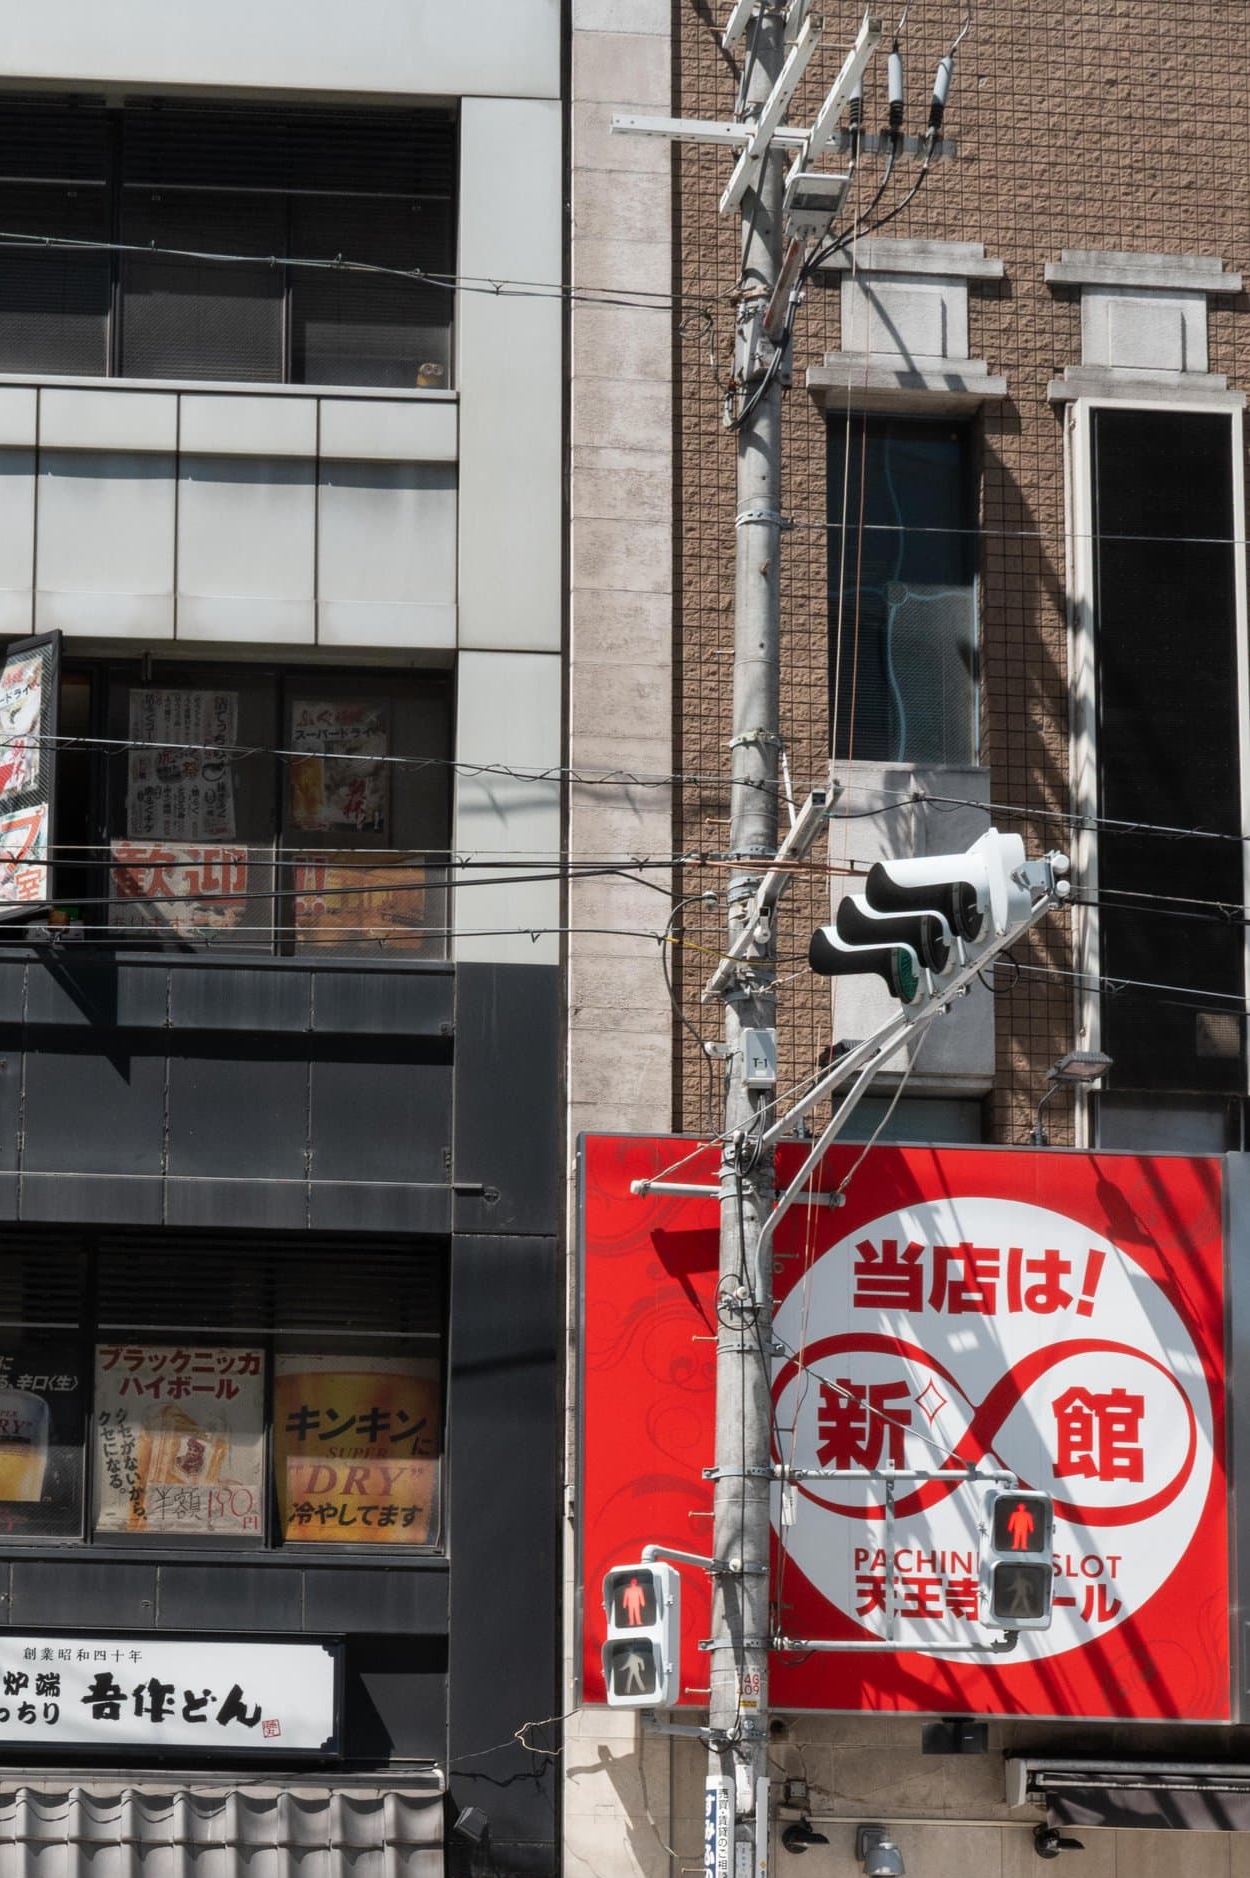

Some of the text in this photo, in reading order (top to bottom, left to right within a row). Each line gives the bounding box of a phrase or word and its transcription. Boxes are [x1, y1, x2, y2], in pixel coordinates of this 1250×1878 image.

[852, 1239, 1107, 1317] 当店は!
[100, 1349, 260, 1375] ブラックニッカ
[119, 1376, 239, 1400] ハイボール
[817, 1378, 1145, 1483] 新 館
[288, 1502, 423, 1528] 冷やしてます
[854, 1548, 980, 1575] PACHIN
[23, 1647, 143, 1664] 創業昭和四十年
[81, 1672, 262, 1729] 吾作どん
